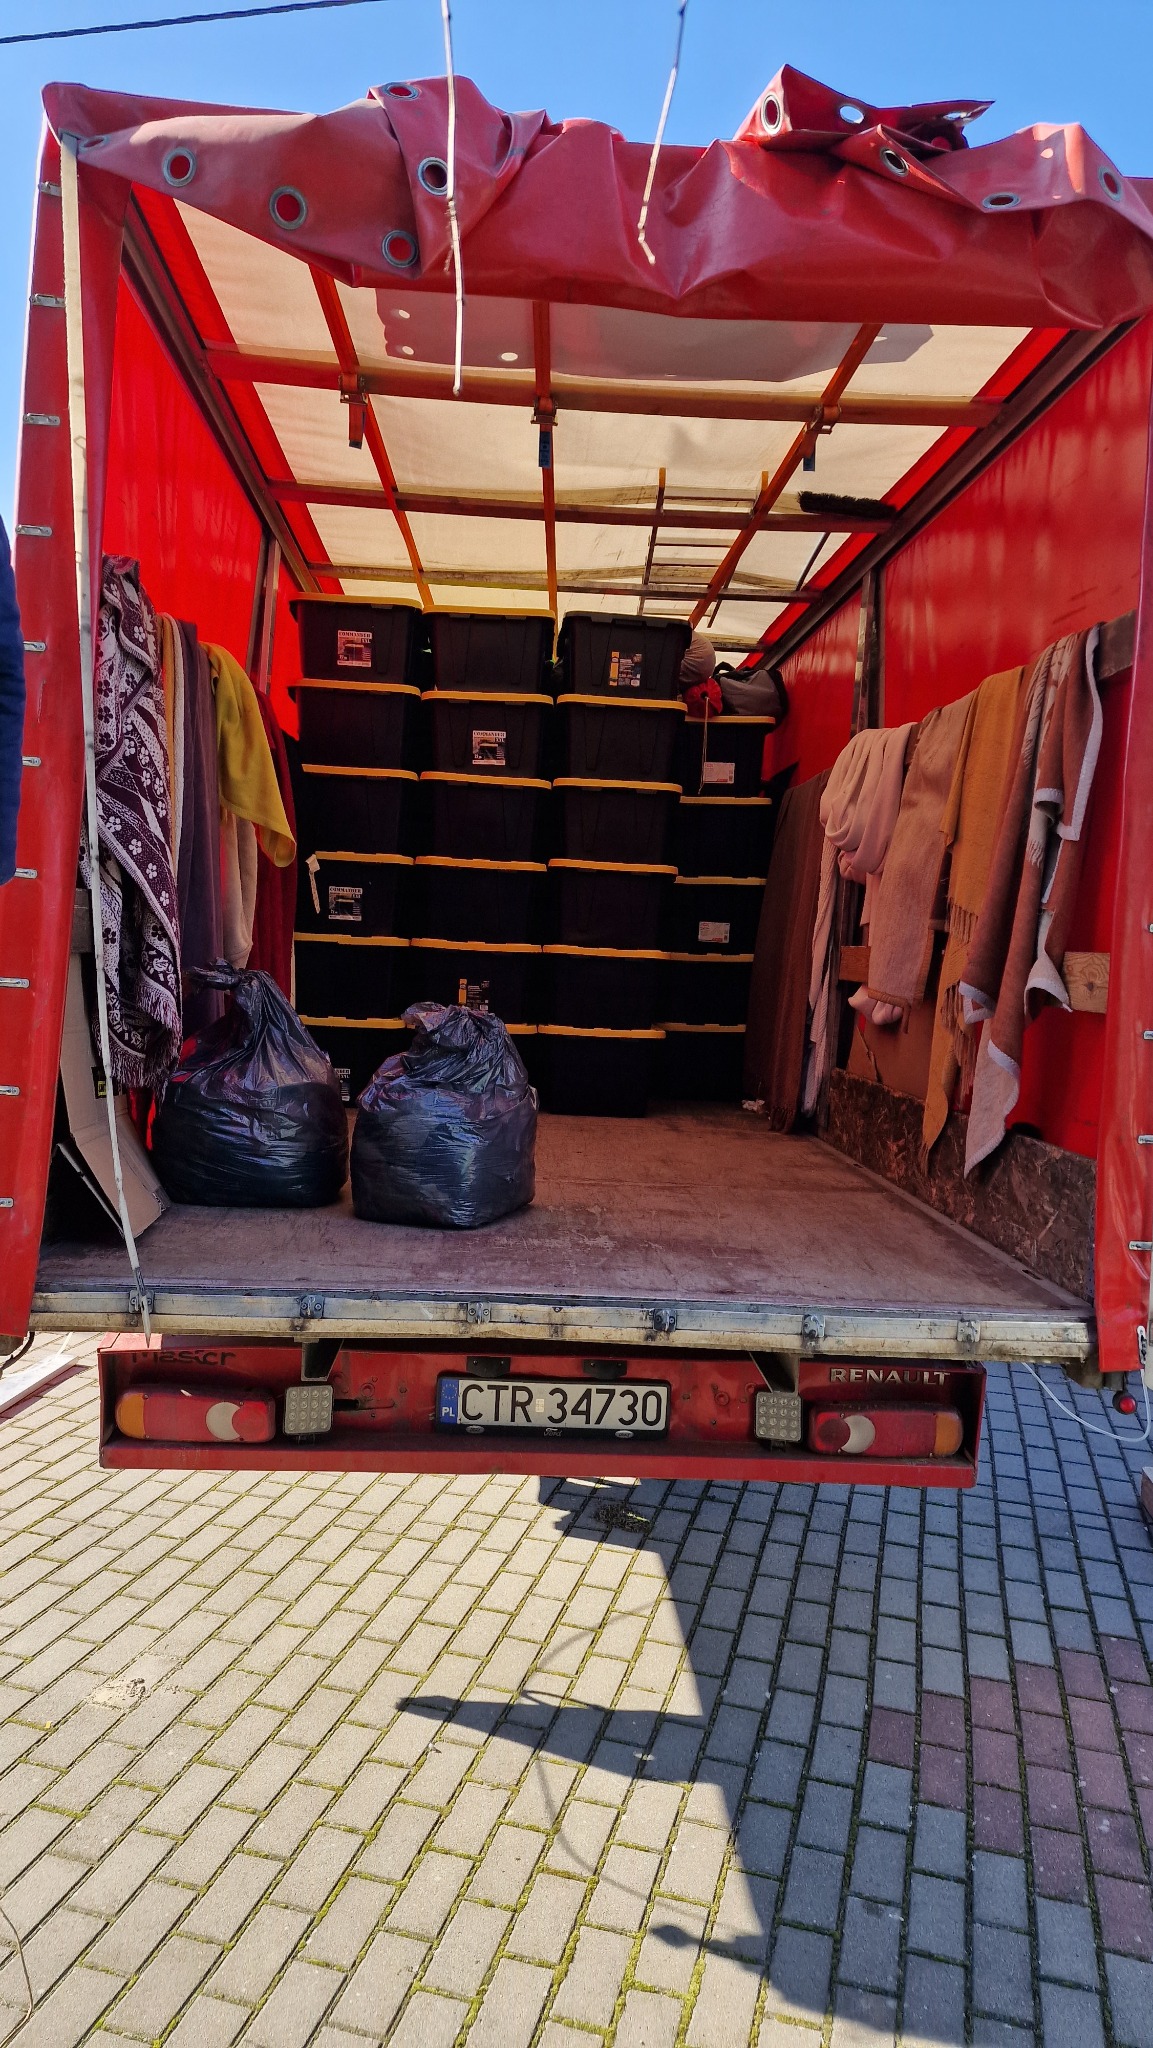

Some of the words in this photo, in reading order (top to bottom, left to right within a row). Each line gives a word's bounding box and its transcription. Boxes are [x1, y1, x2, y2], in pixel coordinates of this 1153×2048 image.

[829, 1368, 951, 1386] RENAULT
[441, 1406, 456, 1418] PL
[461, 1383, 534, 1423] CTR
[547, 1387, 663, 1427] 34730
